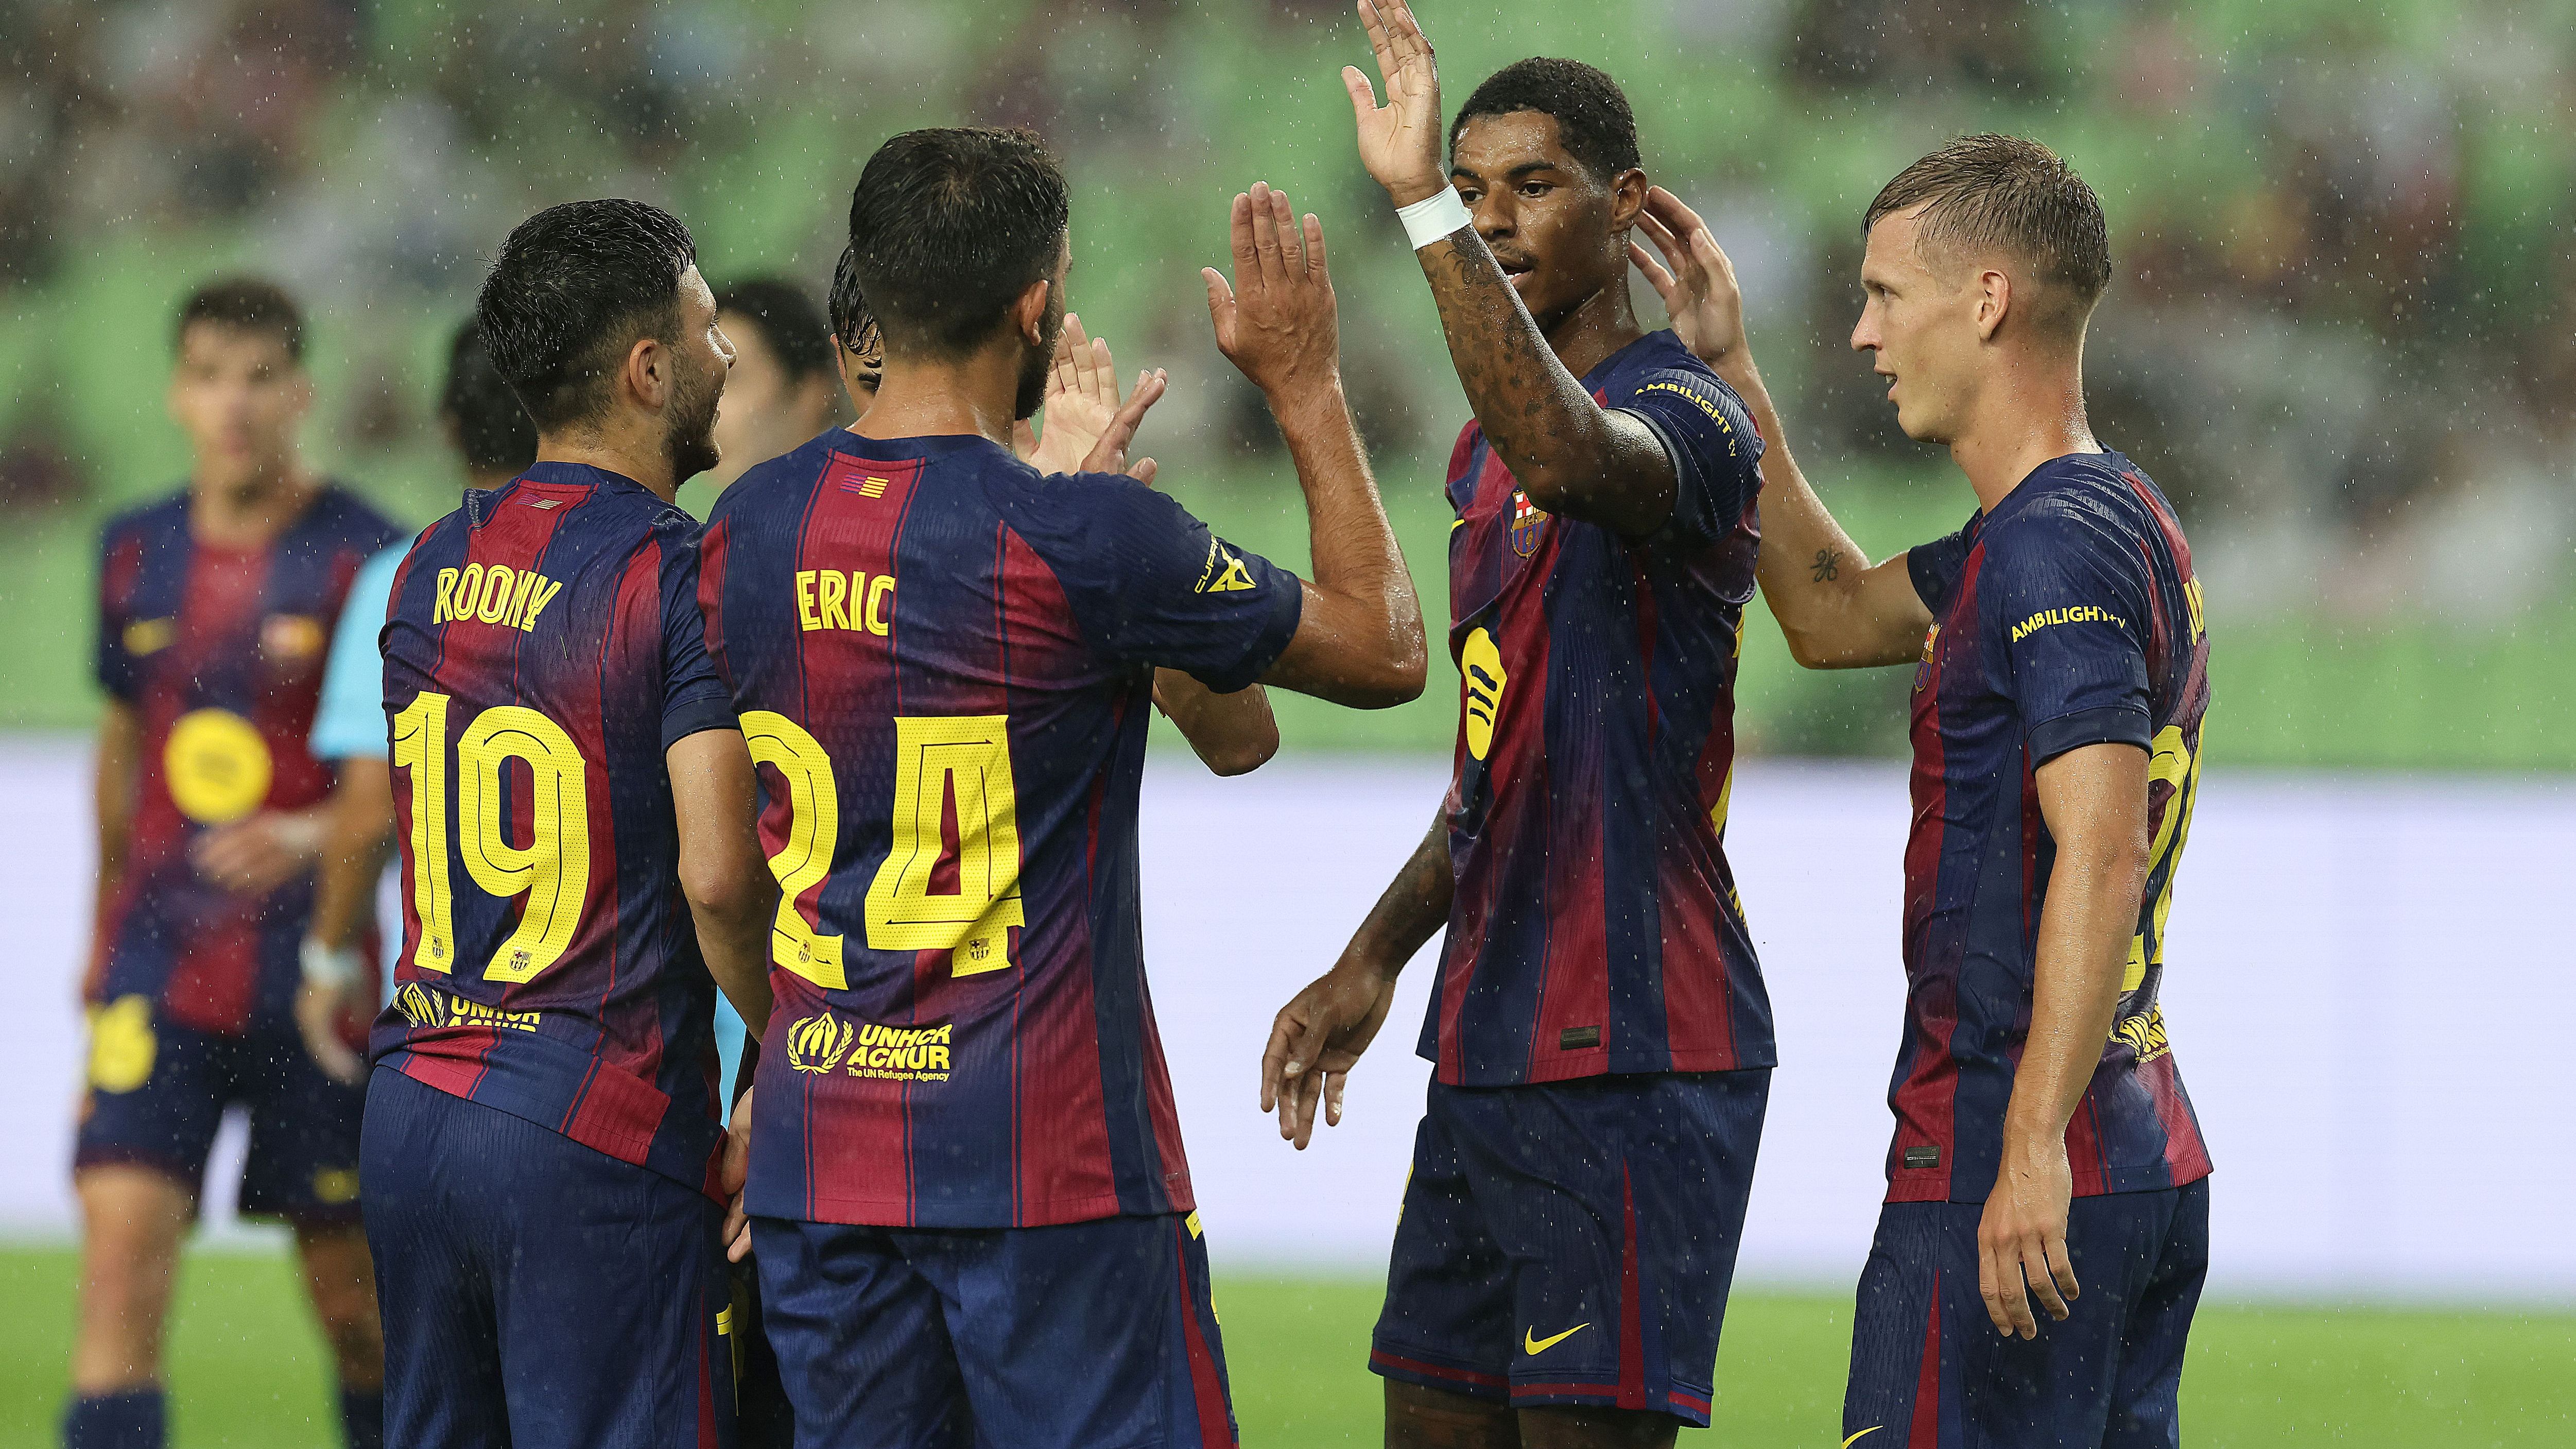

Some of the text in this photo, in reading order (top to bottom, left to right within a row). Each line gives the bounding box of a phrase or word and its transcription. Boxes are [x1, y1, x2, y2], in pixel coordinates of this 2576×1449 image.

[1635, 383, 1732, 434] AMBILIGHT
[433, 562, 563, 633] ROONY
[796, 570, 896, 636] ERIC
[393, 690, 591, 984] 19
[738, 710, 1026, 991] 24
[846, 1045, 950, 1070] ACNUR
[858, 1023, 953, 1048] UNHCR
[847, 1067, 950, 1082] The UN Refugee Agency
